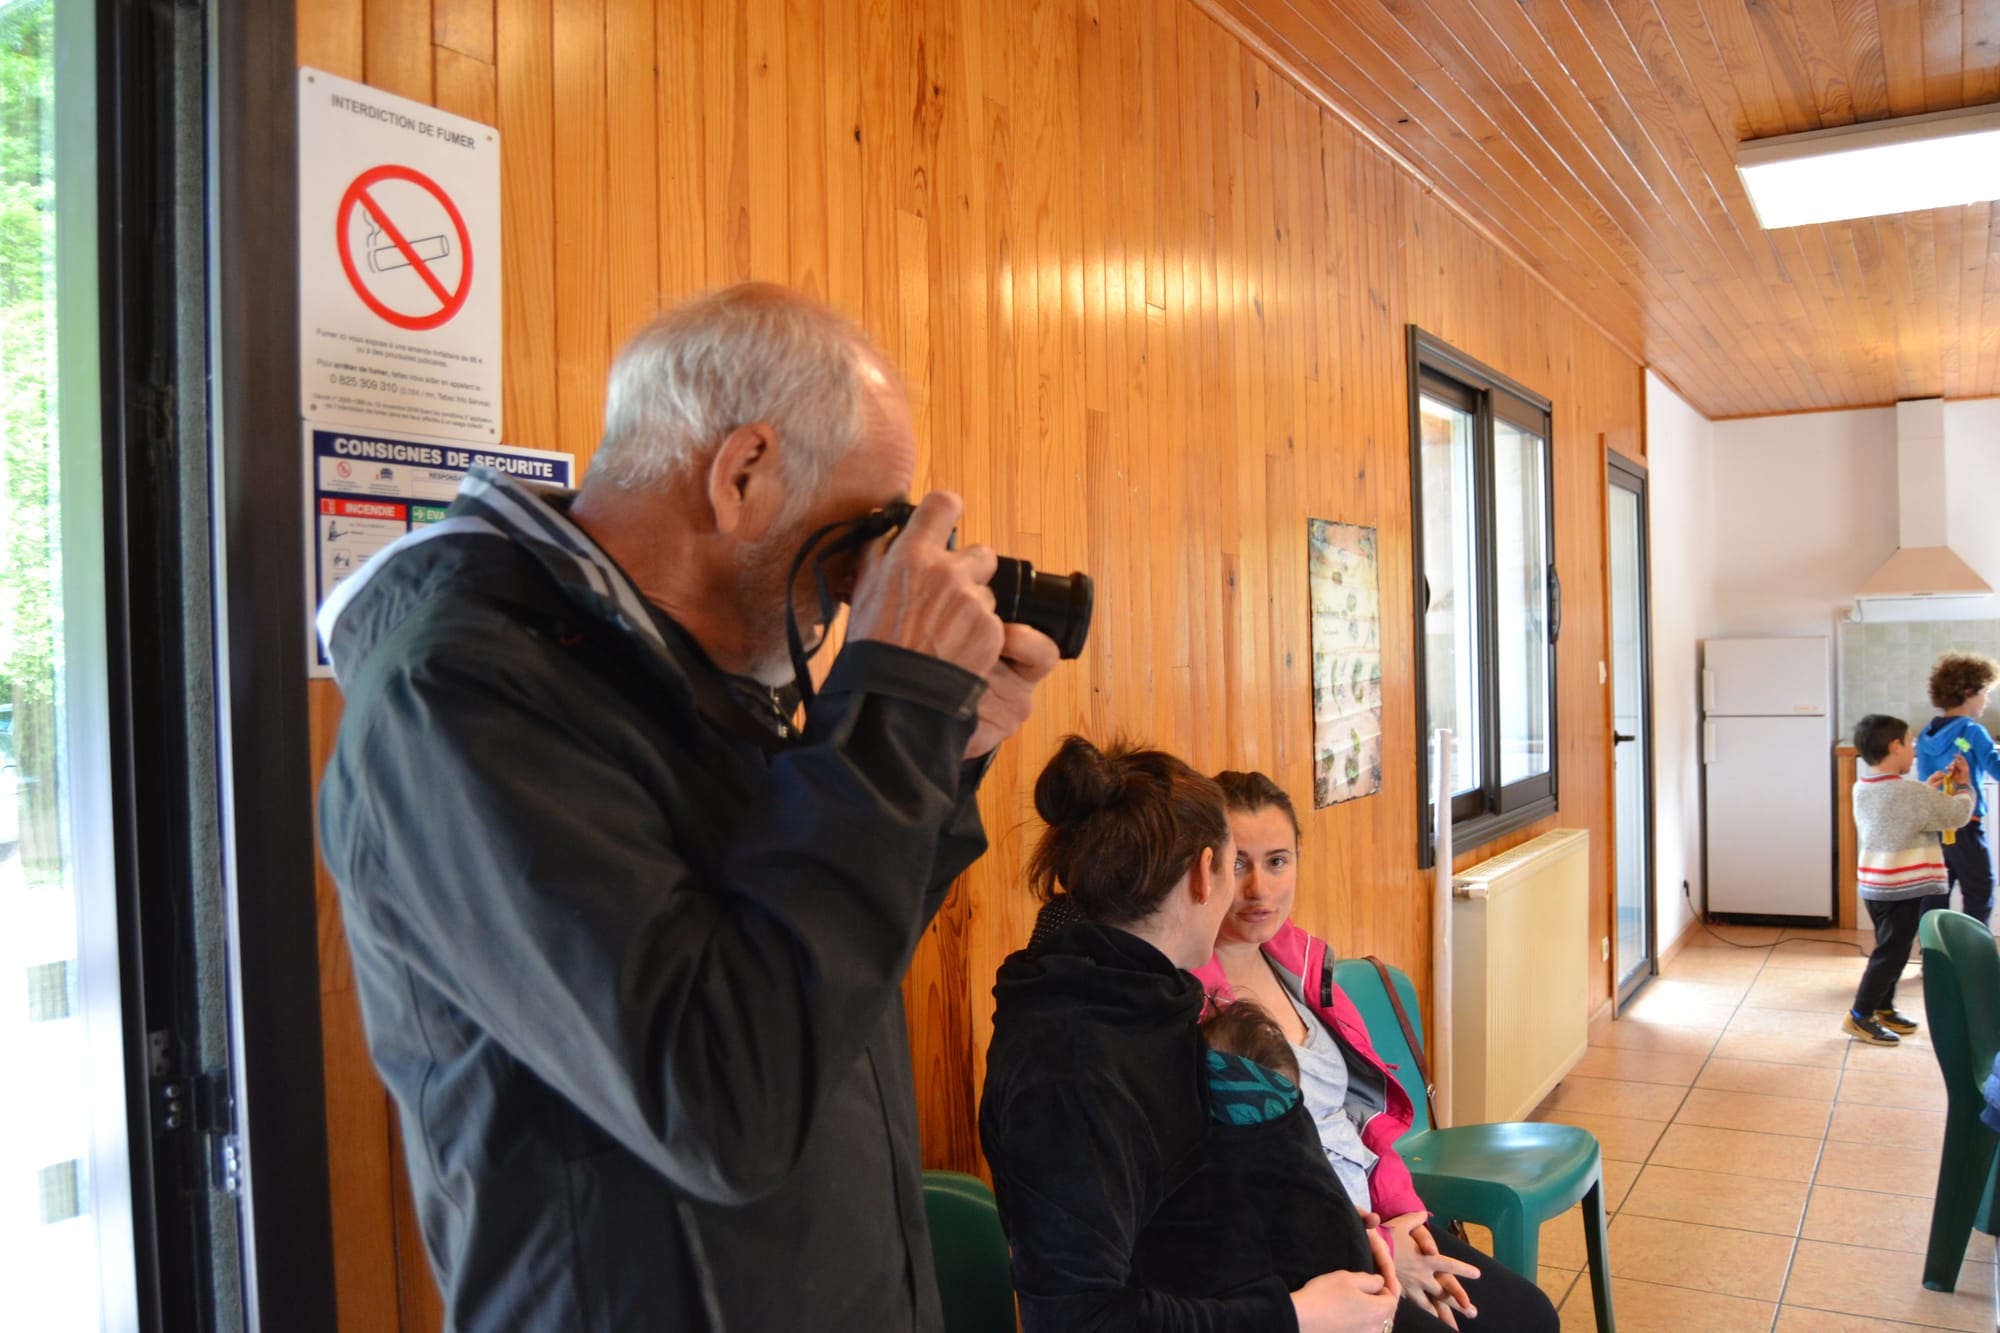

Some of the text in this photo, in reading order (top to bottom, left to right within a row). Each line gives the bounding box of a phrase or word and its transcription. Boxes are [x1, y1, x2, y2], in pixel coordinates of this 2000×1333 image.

[331, 94, 476, 150] INTERDICTION DE FUMER
[339, 375, 358, 387] 825
[380, 380, 398, 393] 310
[334, 437, 553, 478] CONSIGNES DE SECURITE
[345, 503, 397, 517] INCENDIE
